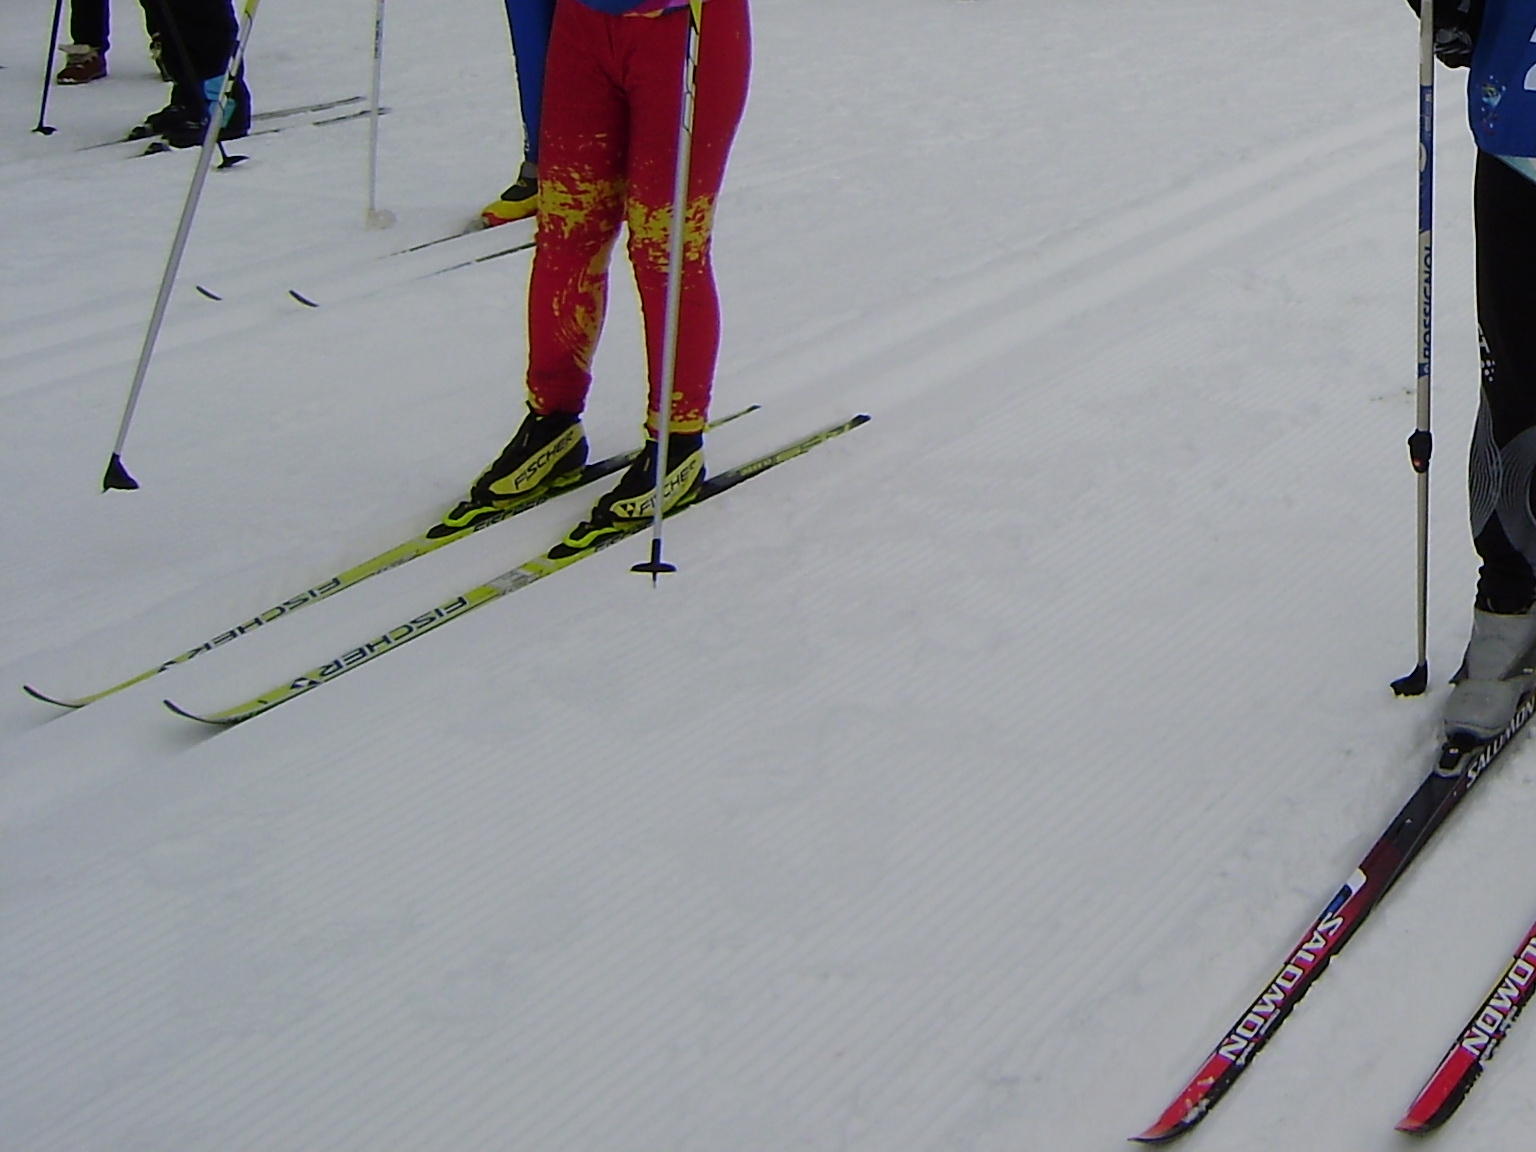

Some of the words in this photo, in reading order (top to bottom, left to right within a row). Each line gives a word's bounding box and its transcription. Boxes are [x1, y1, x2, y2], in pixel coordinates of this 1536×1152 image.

[514, 429, 576, 491] FISCHER
[638, 459, 699, 515] FICHER
[319, 596, 468, 678] FISCHER
[1219, 909, 1344, 1061] SALOMON
